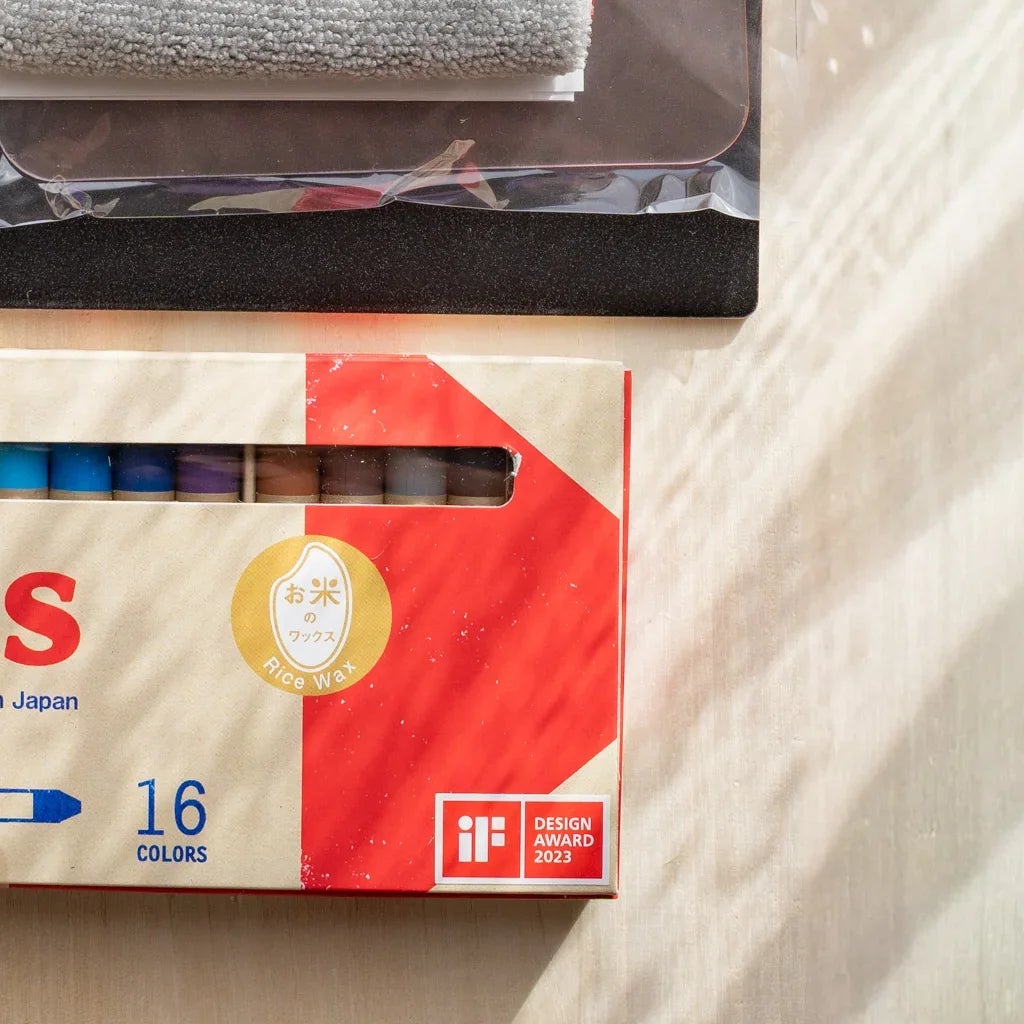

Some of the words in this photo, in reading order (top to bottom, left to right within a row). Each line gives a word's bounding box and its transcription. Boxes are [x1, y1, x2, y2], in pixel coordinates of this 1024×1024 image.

[284, 576, 341, 608] お米
[304, 612, 317, 624] の
[288, 630, 336, 644] ワックス
[262, 656, 305, 690] Rice
[312, 659, 357, 690] Wax
[12, 691, 79, 713] Japan
[136, 778, 207, 836] 16
[533, 816, 592, 831] DESIGN
[532, 833, 595, 848] AWARD
[136, 844, 208, 864] COLORS
[533, 850, 572, 864] 2023
